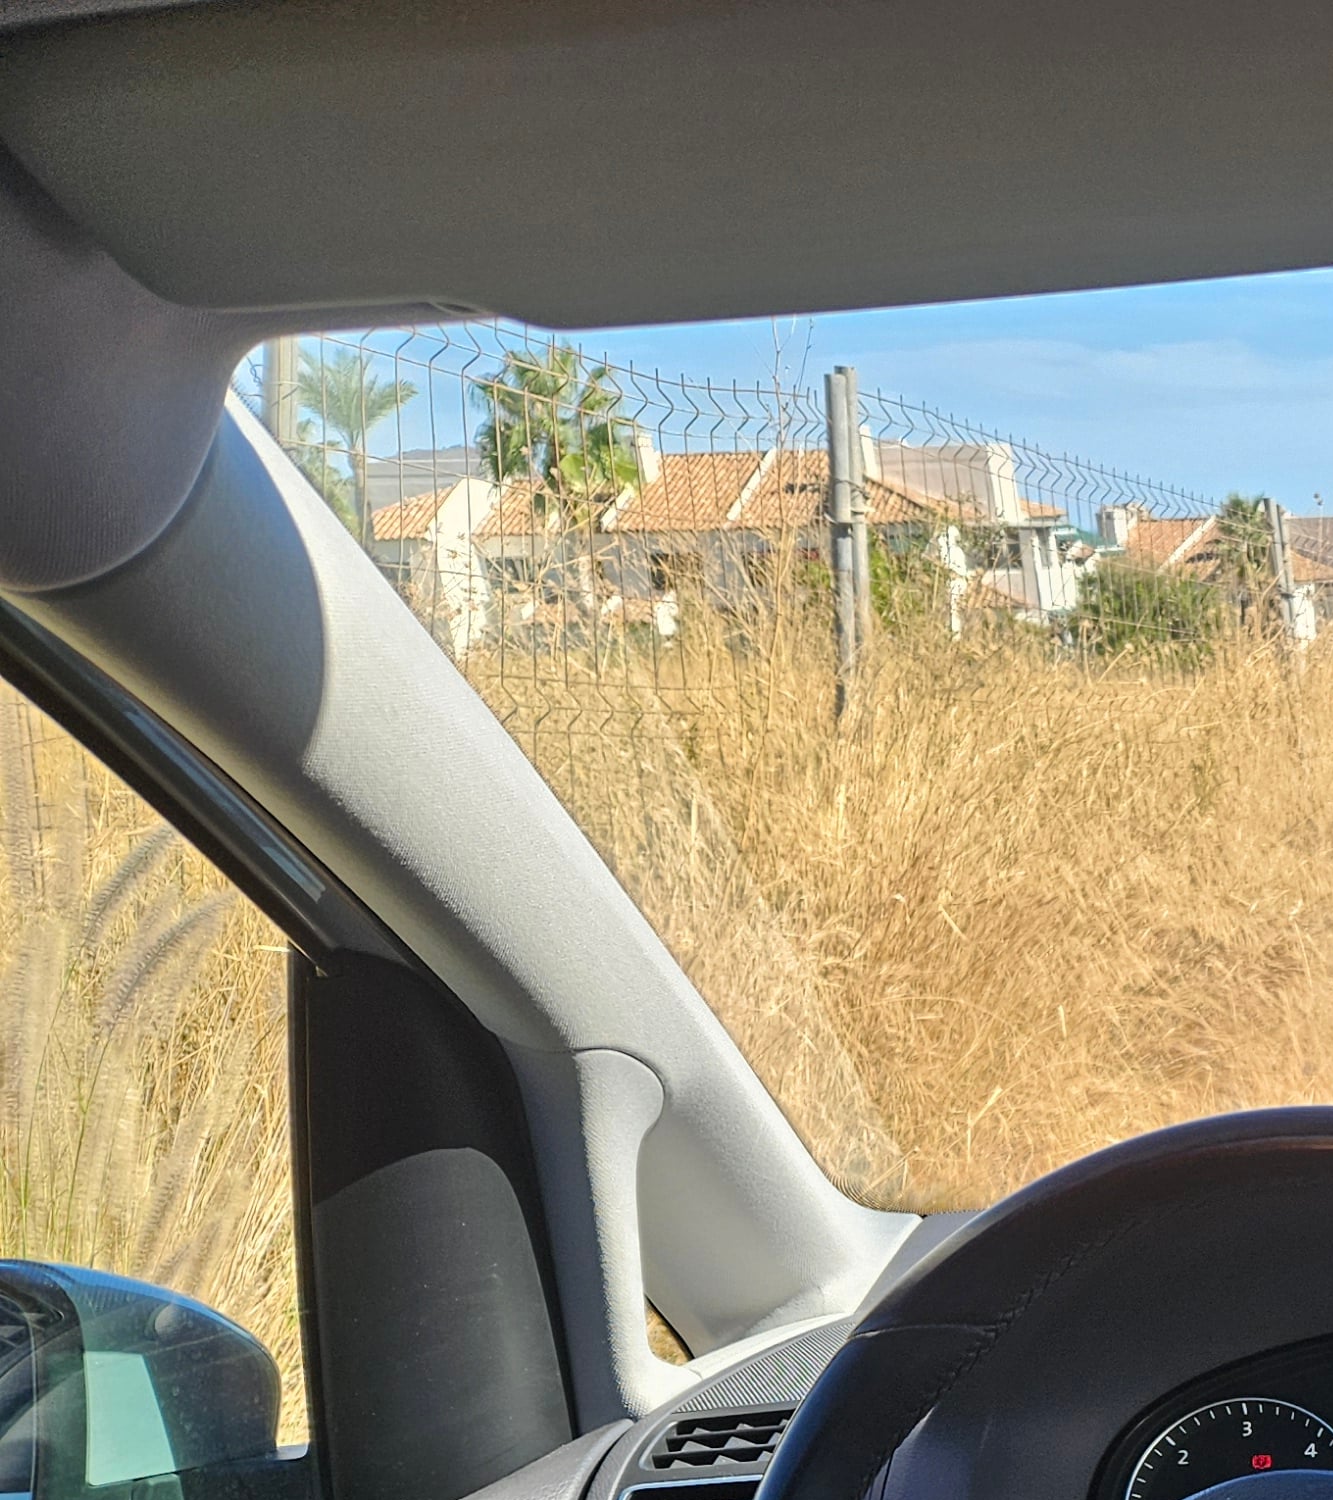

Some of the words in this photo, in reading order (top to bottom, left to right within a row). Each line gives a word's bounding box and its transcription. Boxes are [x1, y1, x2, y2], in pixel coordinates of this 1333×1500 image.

[1241, 1421, 1252, 1437] 3
[1177, 1450, 1190, 1466] 2
[1304, 1443, 1318, 1458] 4
